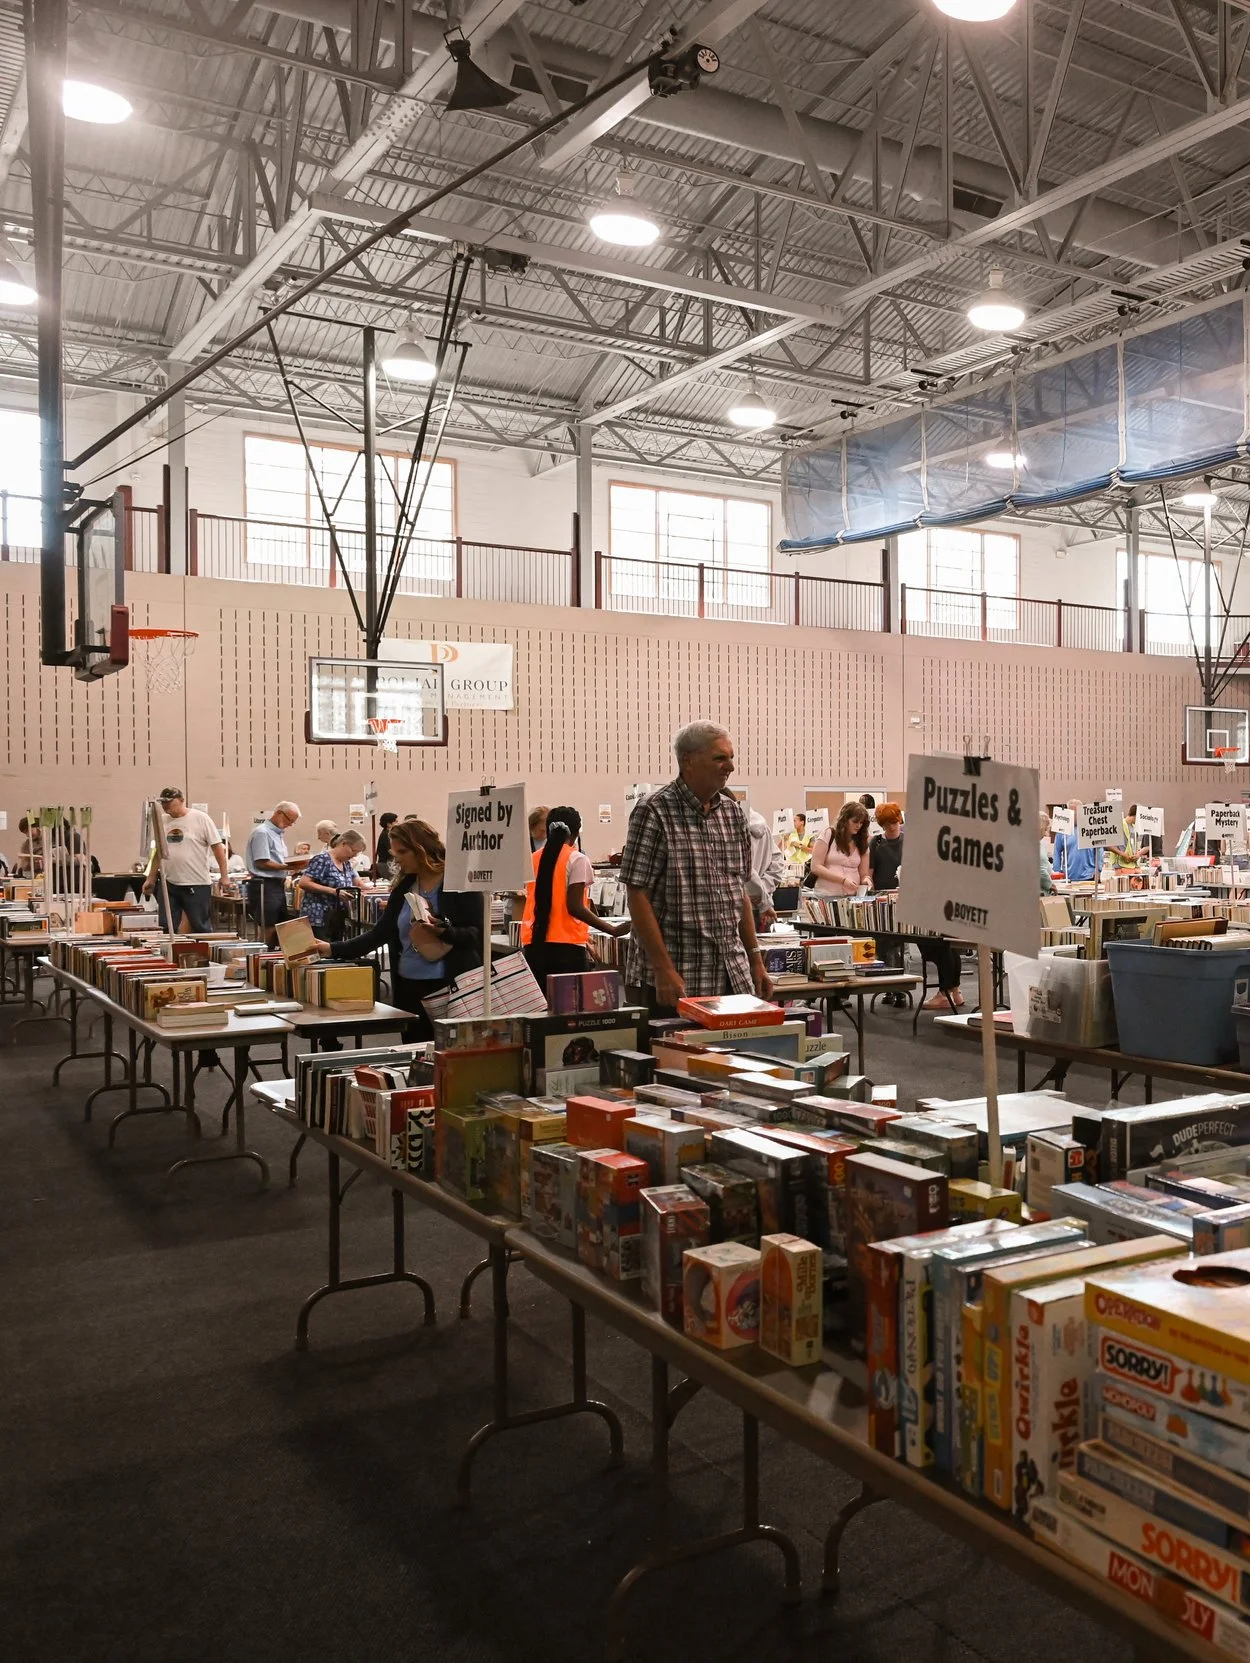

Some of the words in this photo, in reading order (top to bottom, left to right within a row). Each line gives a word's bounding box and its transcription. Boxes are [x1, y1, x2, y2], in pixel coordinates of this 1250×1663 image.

[450, 679, 508, 692] GROUP
[430, 692, 508, 700] MNAGEMENT
[923, 776, 999, 823] Puzzles
[1007, 788, 1022, 827] &
[455, 800, 492, 829] Signed
[497, 803, 513, 827] by
[1083, 804, 1113, 816] Treasure
[1210, 809, 1241, 821] Paperback
[777, 815, 787, 823] Math
[1088, 815, 1108, 826] Chest
[1139, 813, 1159, 824] Sociology
[1215, 818, 1239, 828] Mystery
[1081, 825, 1118, 839] Paperback
[461, 830, 504, 852] Author
[937, 825, 1004, 873] Games
[473, 870, 493, 880] BOYETT
[954, 902, 989, 925] BOYETT
[578, 1019, 601, 1027] PUZZLE
[602, 1017, 616, 1025] 1000
[723, 1030, 748, 1039] Bison
[805, 1041, 827, 1053] uzzle
[1105, 1343, 1170, 1386] SORRY!
[1014, 1323, 1032, 1441] Qwirkle
[1052, 1376, 1079, 1470] irkle
[1140, 1521, 1241, 1604] SORRY!
[1110, 1556, 1213, 1632] MONLY
